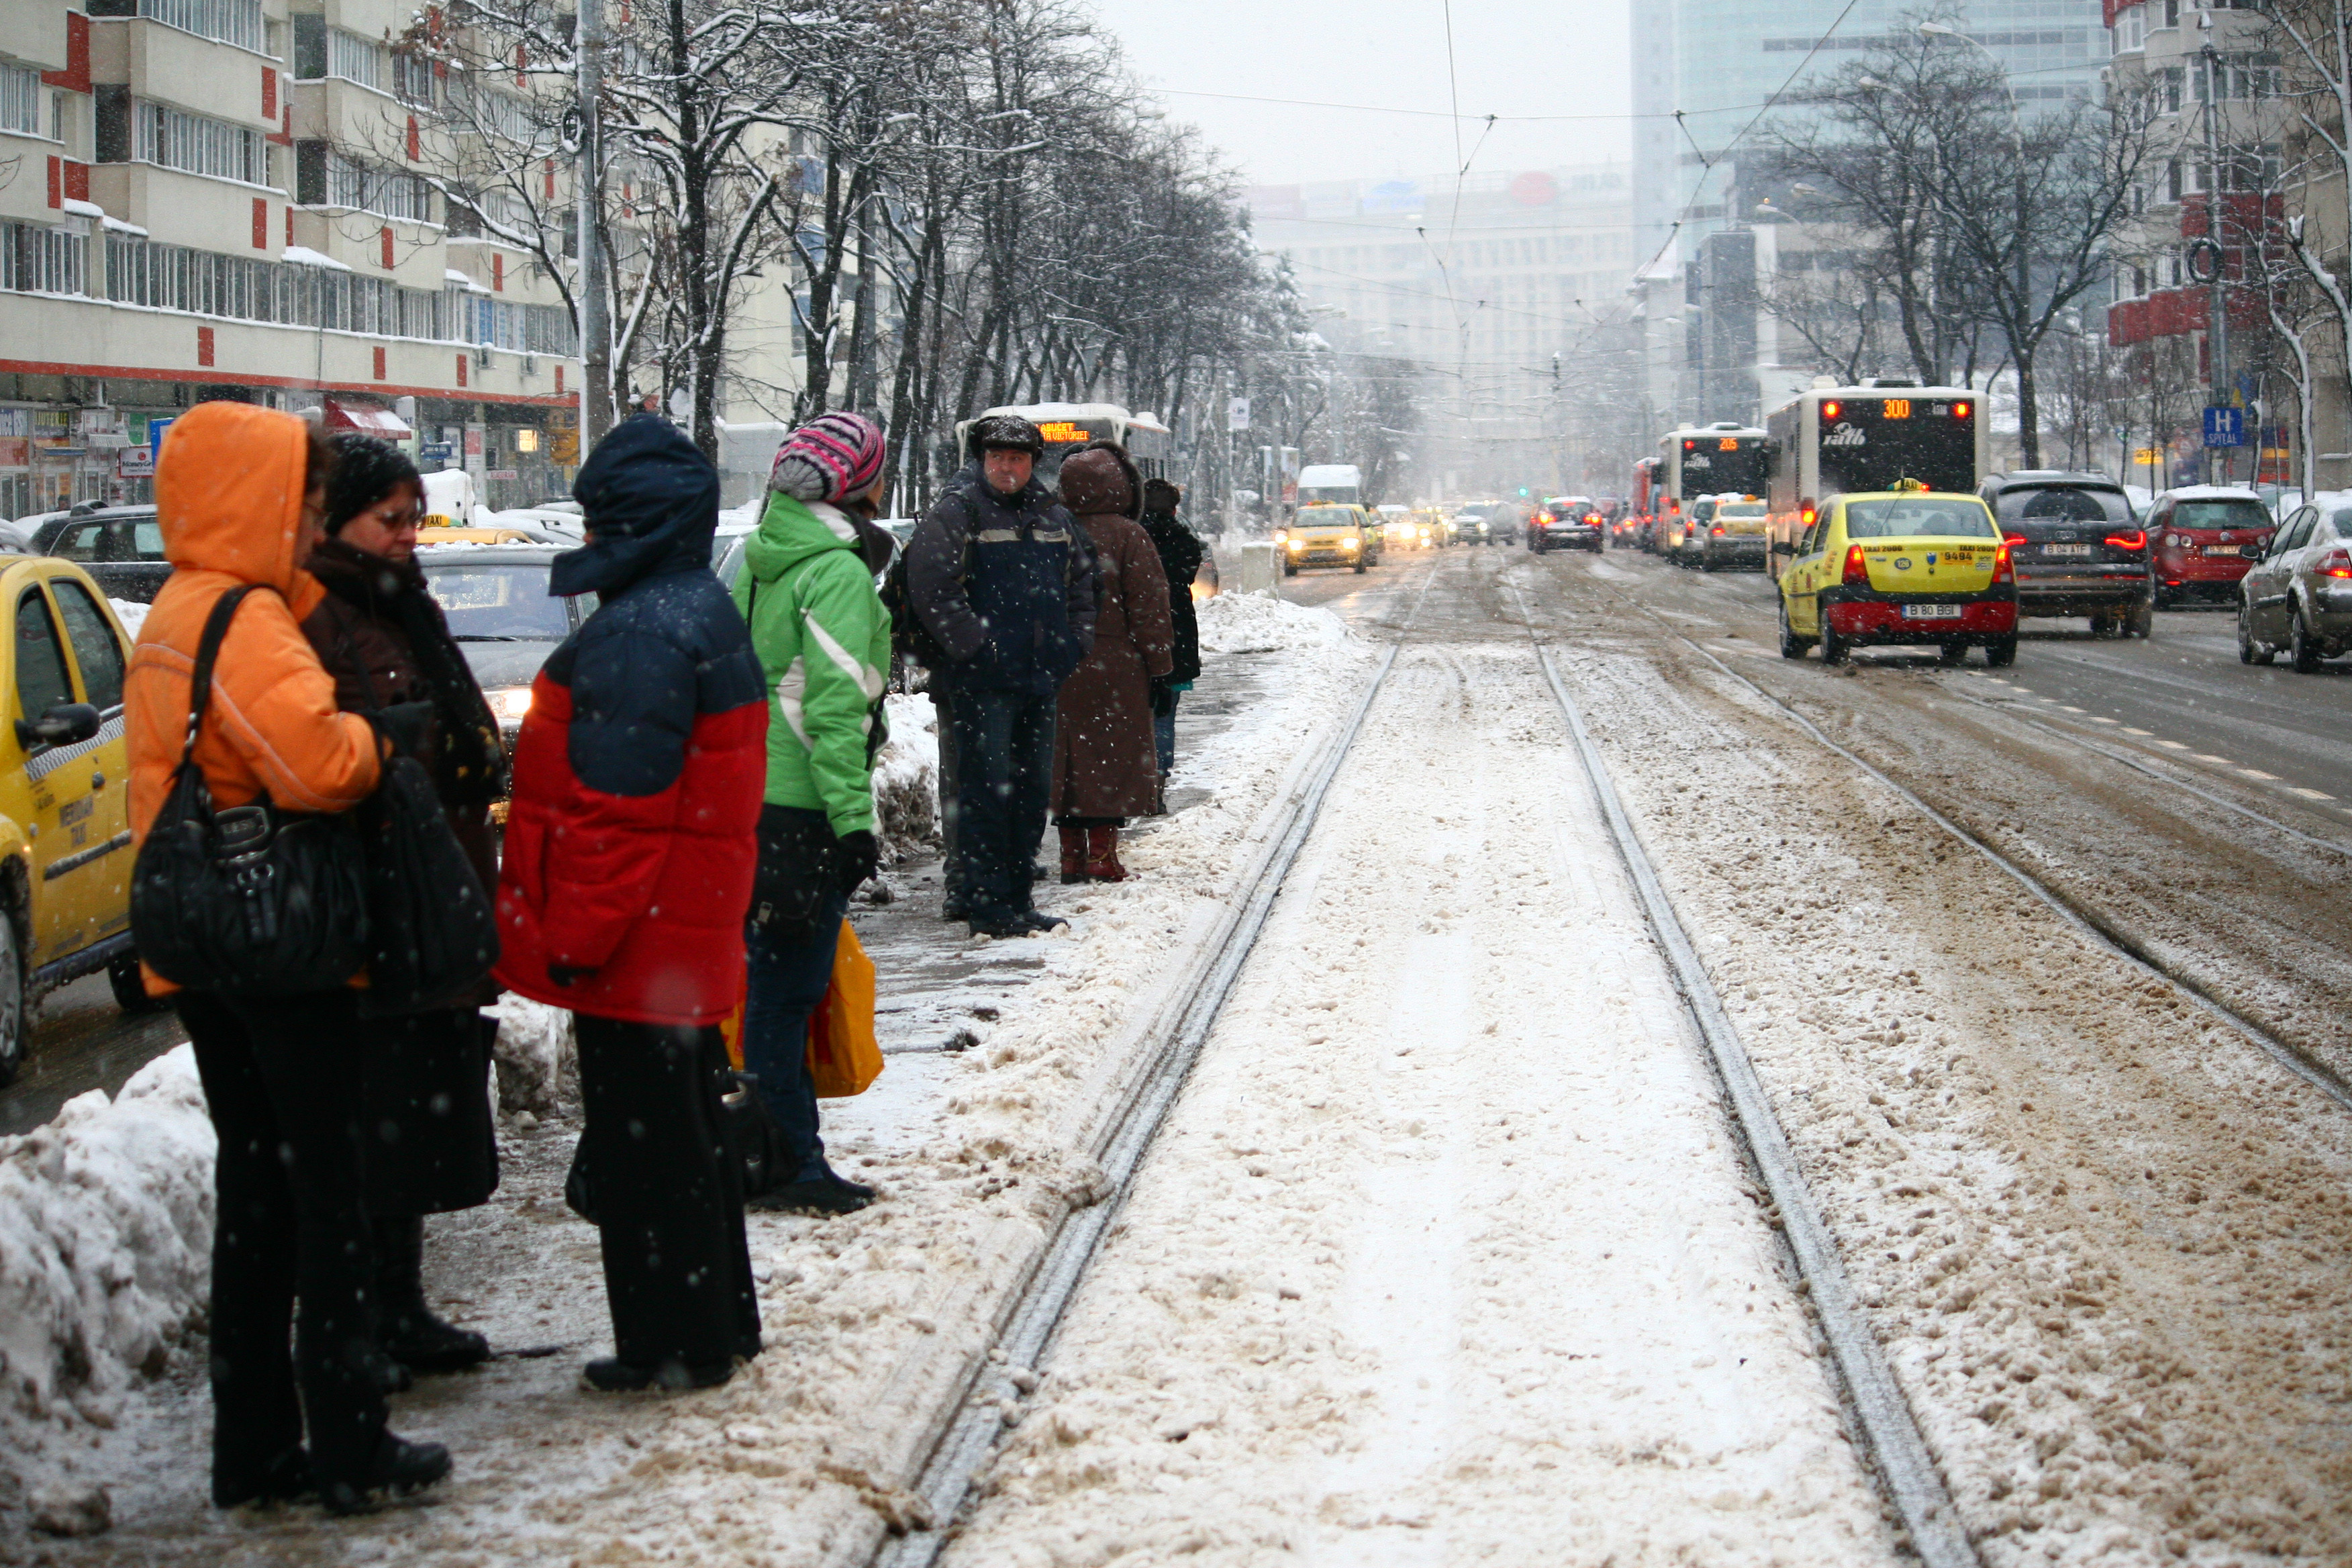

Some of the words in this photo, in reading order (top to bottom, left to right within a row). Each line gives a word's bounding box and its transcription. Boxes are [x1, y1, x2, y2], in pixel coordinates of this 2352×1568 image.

[1883, 399, 1910, 418] 300
[2215, 410, 2231, 432] H
[1040, 422, 1075, 432] ABUCET
[1042, 432, 1051, 440] TA
[1052, 431, 1087, 440] VICTORIEI
[2208, 433, 2237, 445] SPITAL
[1720, 438, 1737, 450] 205
[426, 516, 442, 526] TAXI
[1944, 552, 1972, 560] 9494
[1910, 606, 1918, 615] B
[1922, 606, 1933, 615] 80
[1937, 606, 1955, 615] BGI
